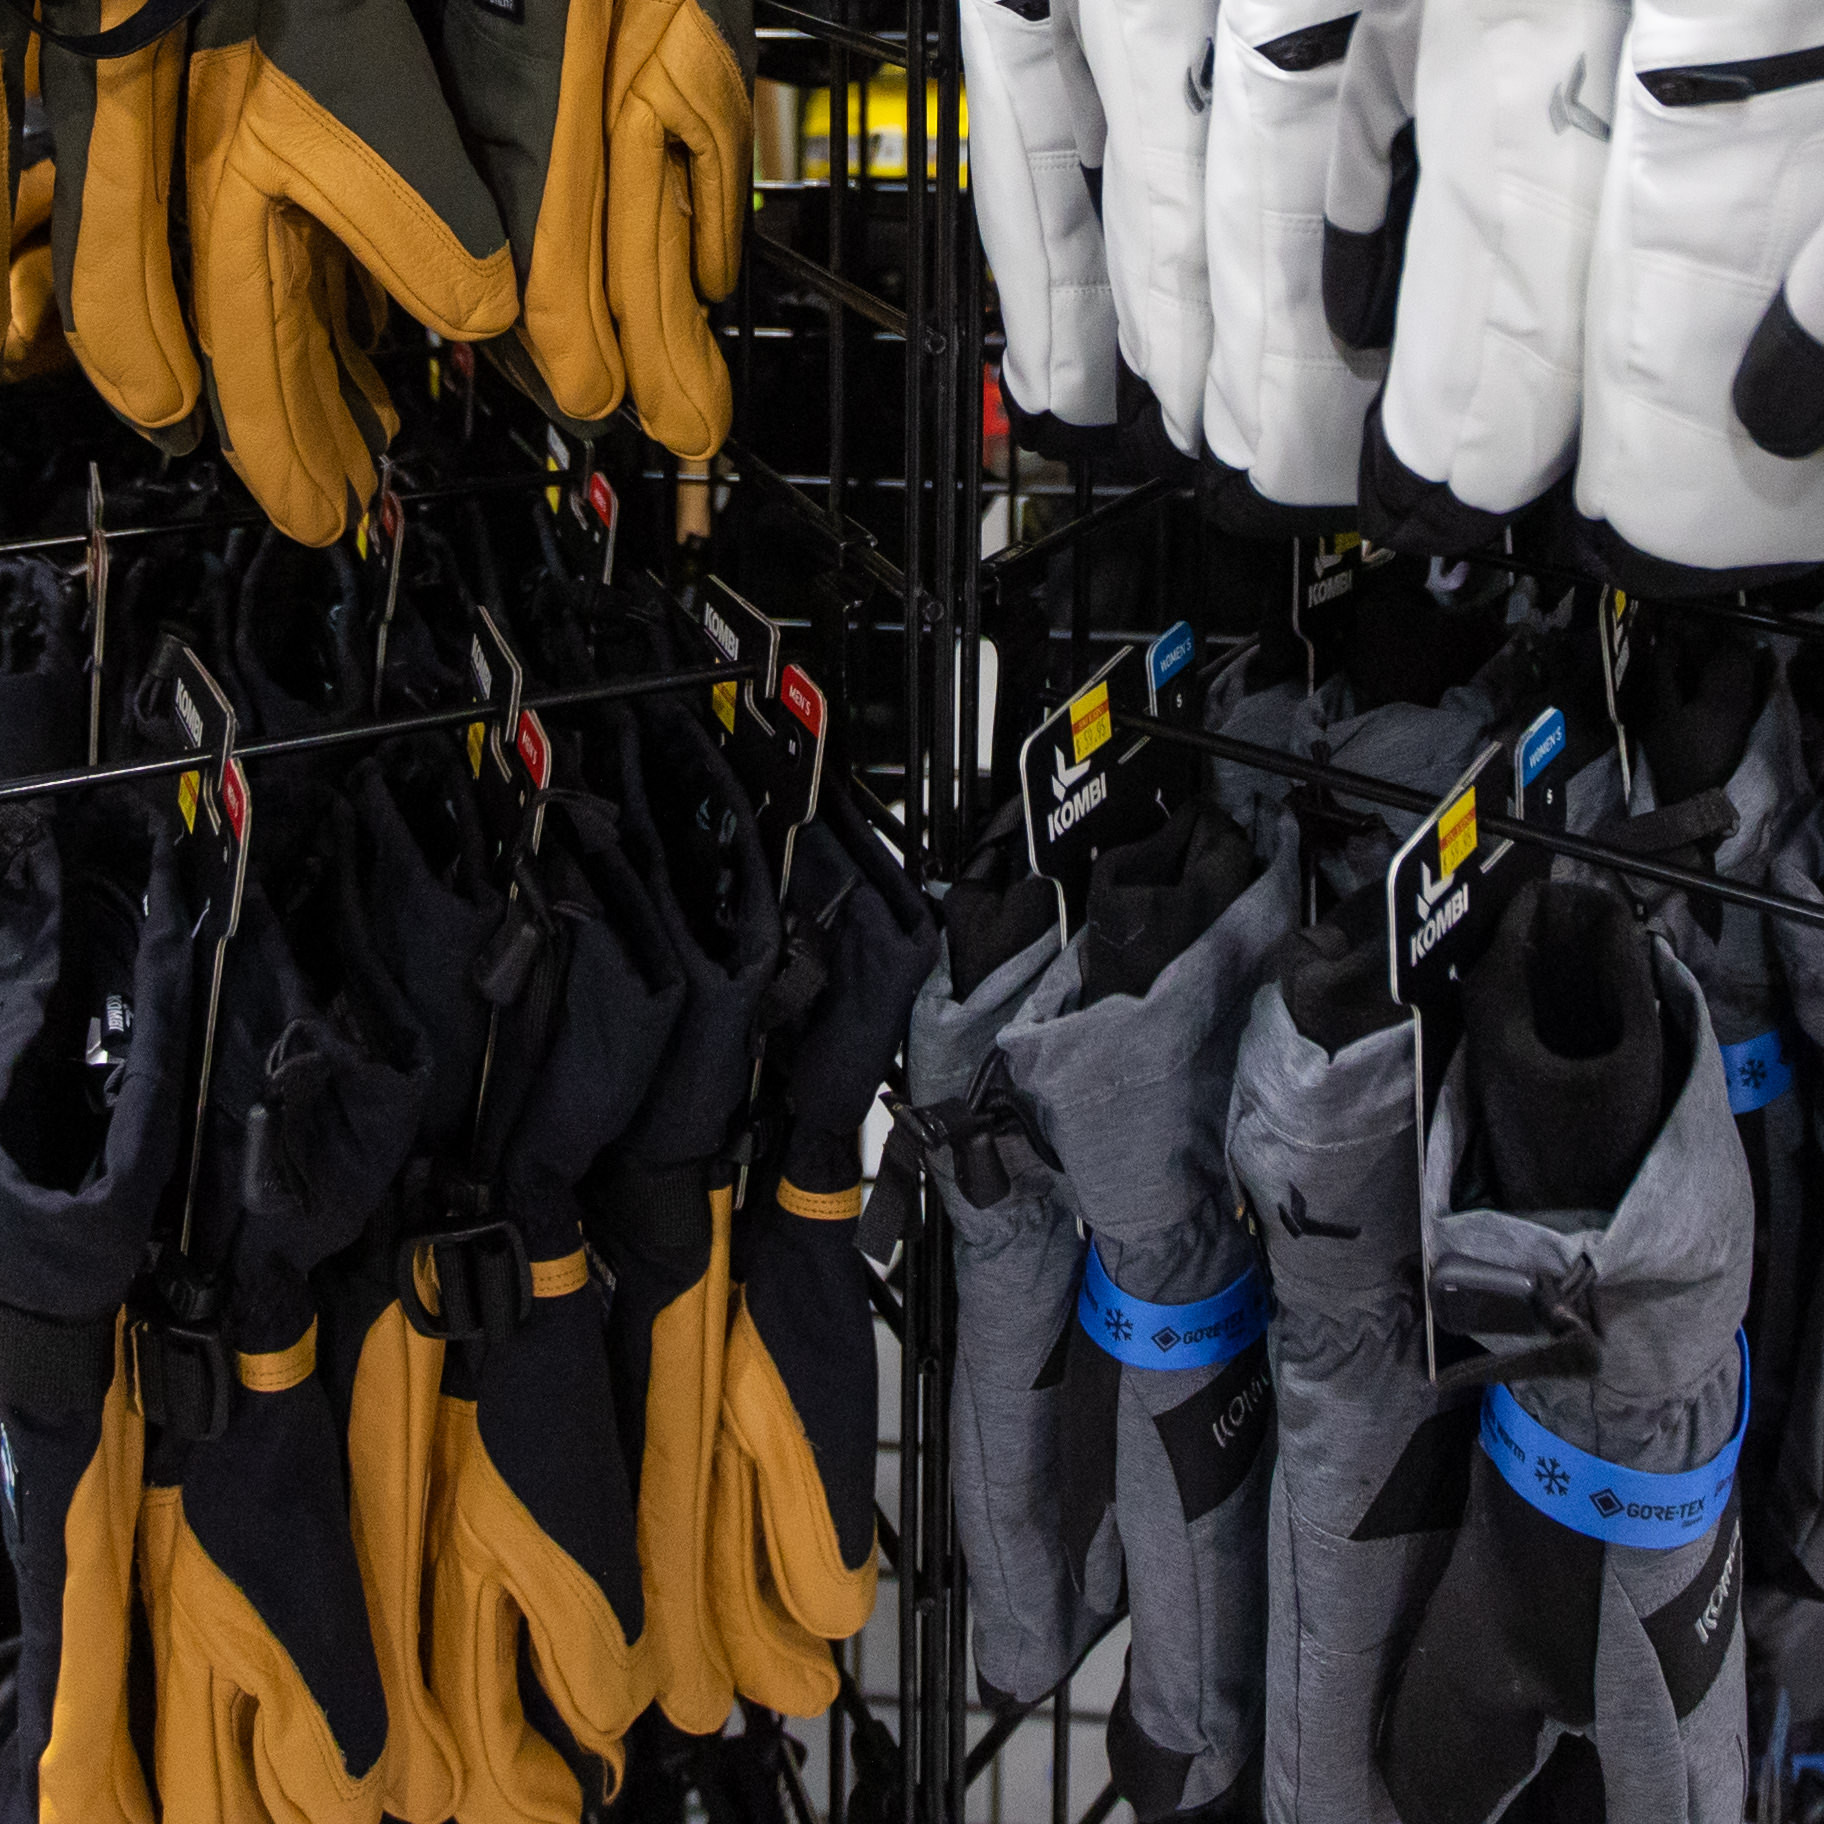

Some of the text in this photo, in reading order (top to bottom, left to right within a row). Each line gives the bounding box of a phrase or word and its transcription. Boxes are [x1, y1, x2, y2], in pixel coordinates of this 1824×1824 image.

[1307, 569, 1354, 609] KOMBI
[702, 602, 739, 662] KOMBI
[1159, 637, 1193, 674] WOMEN'S
[175, 676, 205, 749] KOMBI
[788, 683, 811, 717] MEN'S
[1176, 693, 1183, 709] S
[1528, 725, 1563, 770] WOMEN'S
[1045, 771, 1108, 844] KOMBI
[1410, 881, 1469, 969] KOMBI
[106, 993, 124, 1033] KOMBI
[1182, 1310, 1246, 1346] GORE-TEX
[1626, 1495, 1706, 1523] GORE-TEX
